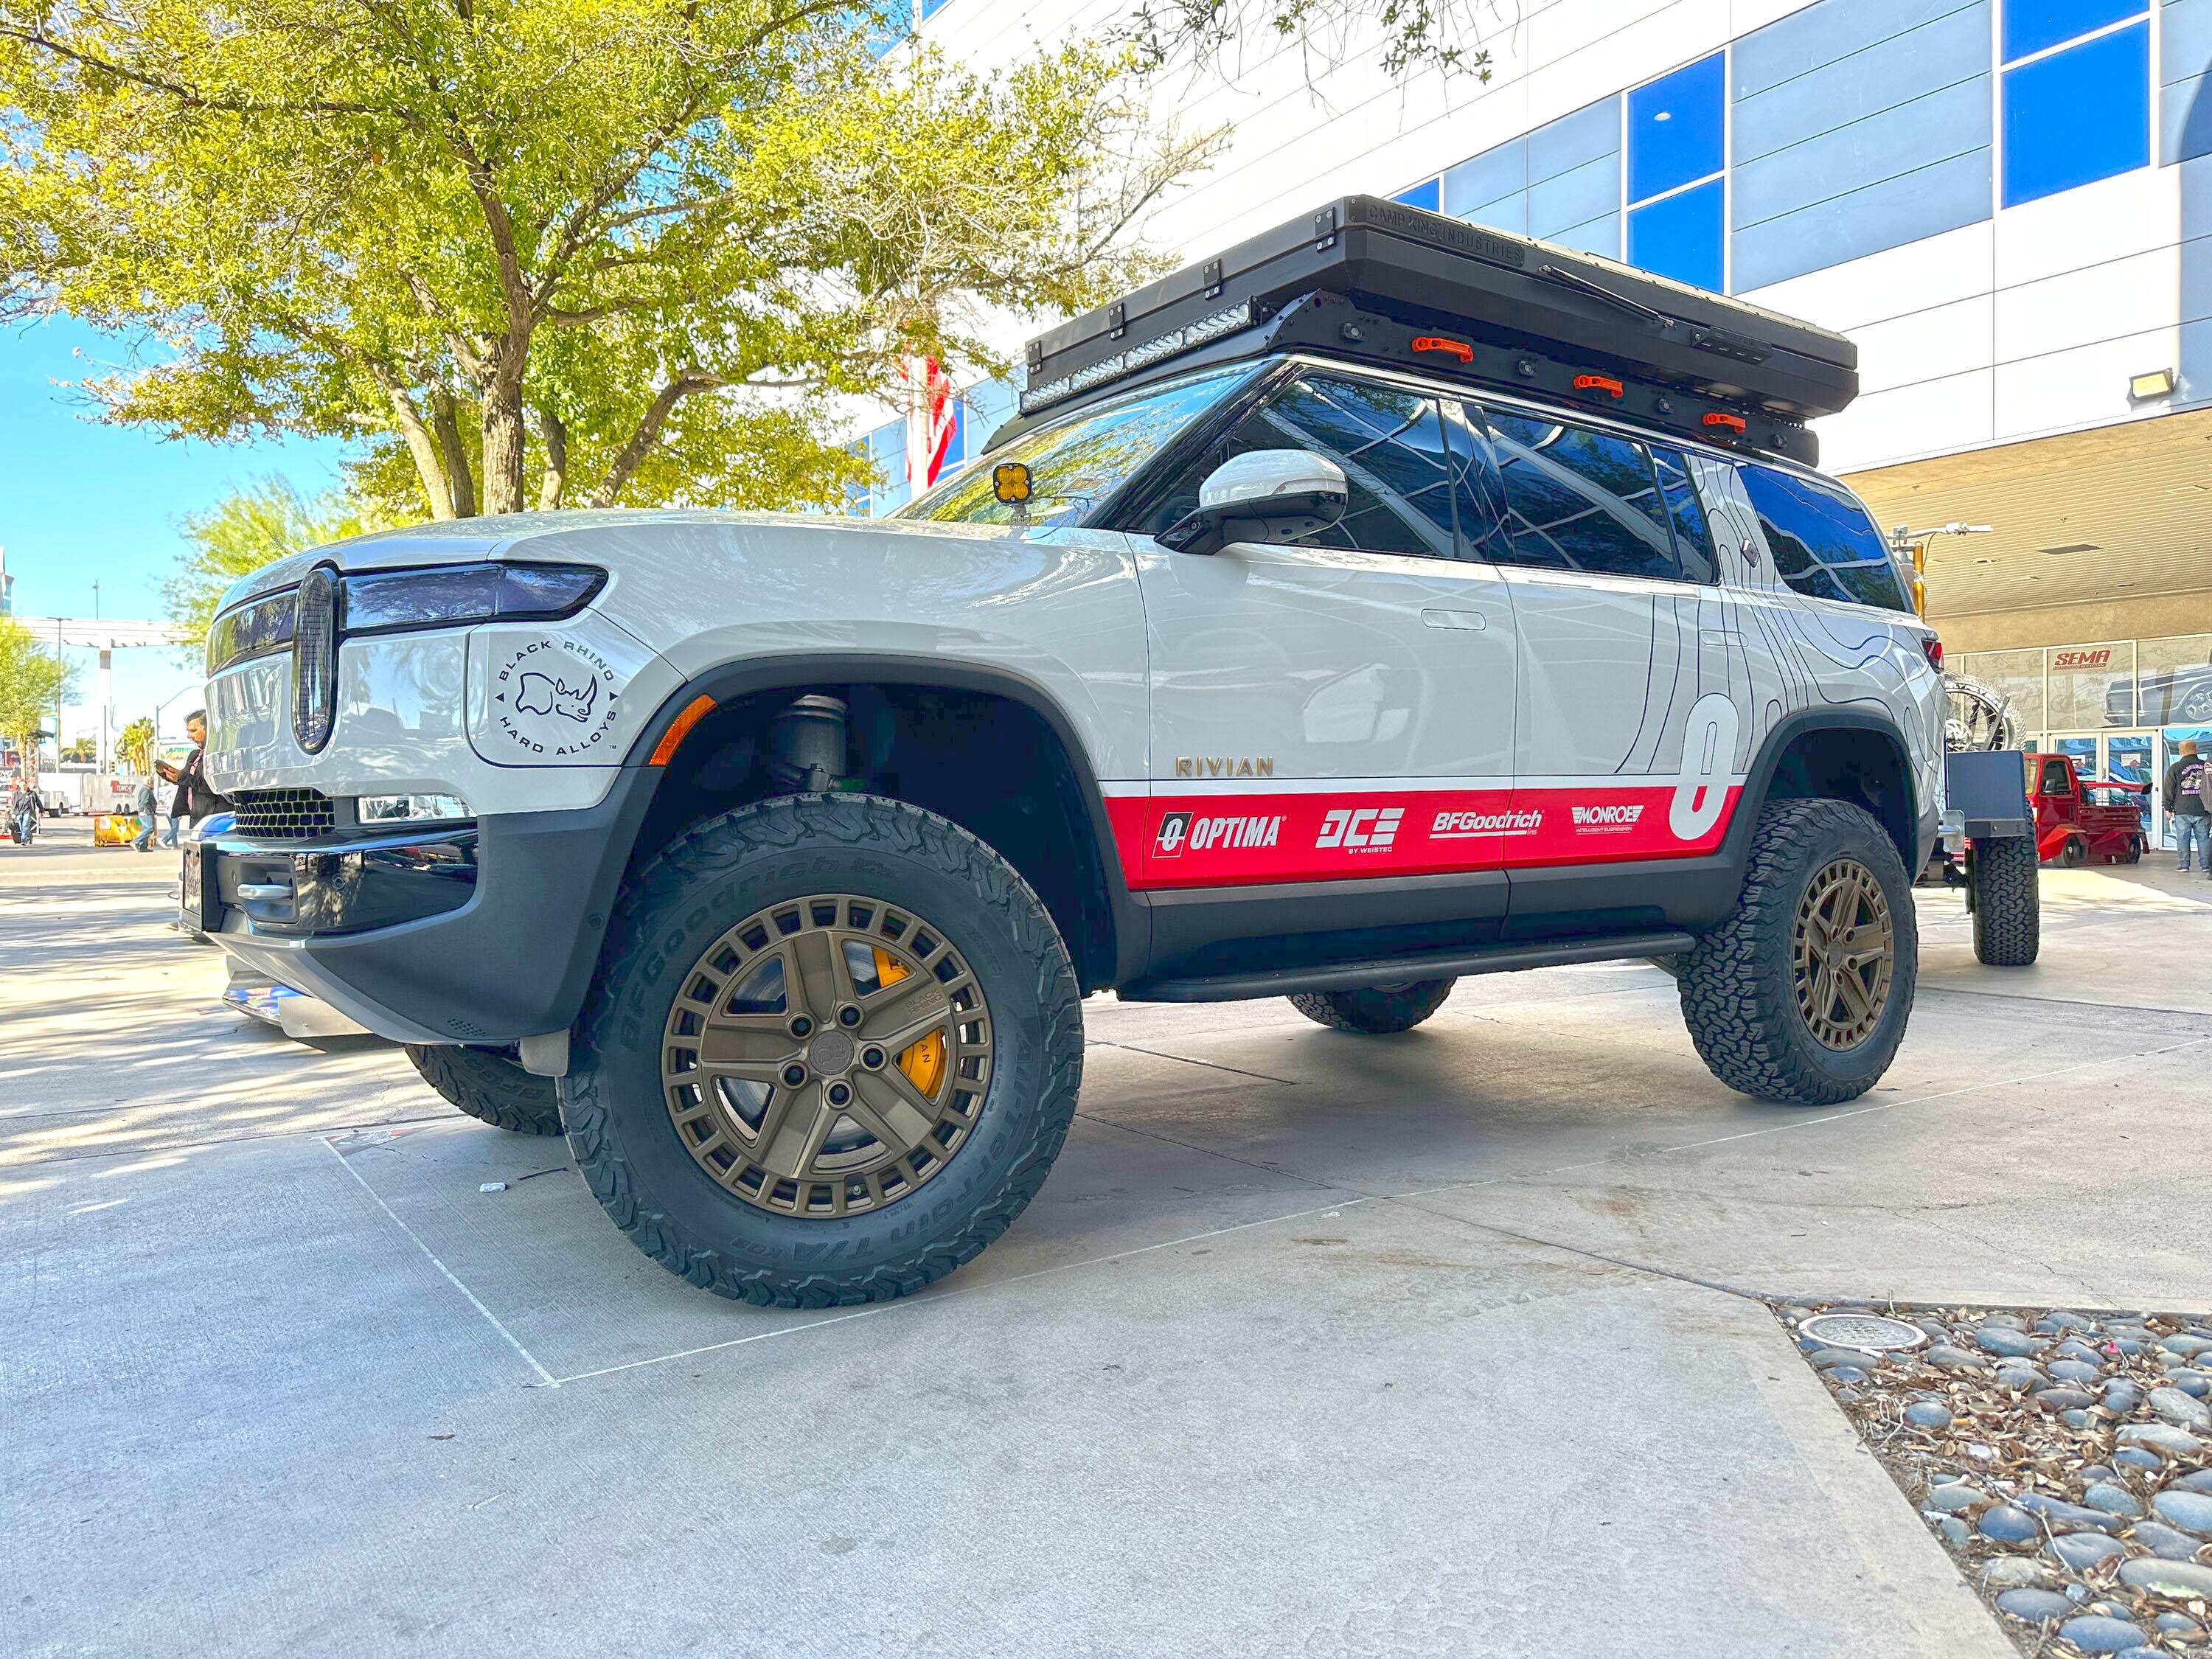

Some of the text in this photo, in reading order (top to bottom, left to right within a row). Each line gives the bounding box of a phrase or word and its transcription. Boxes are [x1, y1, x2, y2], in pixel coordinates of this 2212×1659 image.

[1369, 205, 1522, 261] CAMP KING INDUSTRIES
[498, 641, 614, 681] BLACK RHINO
[2054, 650, 2110, 665] SEMA
[500, 710, 616, 756] HARD ALLOYS
[1175, 757, 1274, 776] RIVIAN
[1431, 810, 1543, 832] BFGoodrich
[1580, 805, 1633, 824] MONROE
[1189, 815, 1281, 850] OPTIMA
[619, 855, 841, 1053] BFGoodrich
[906, 989, 939, 1008] BLACK
[908, 994, 942, 1015] RHINO
